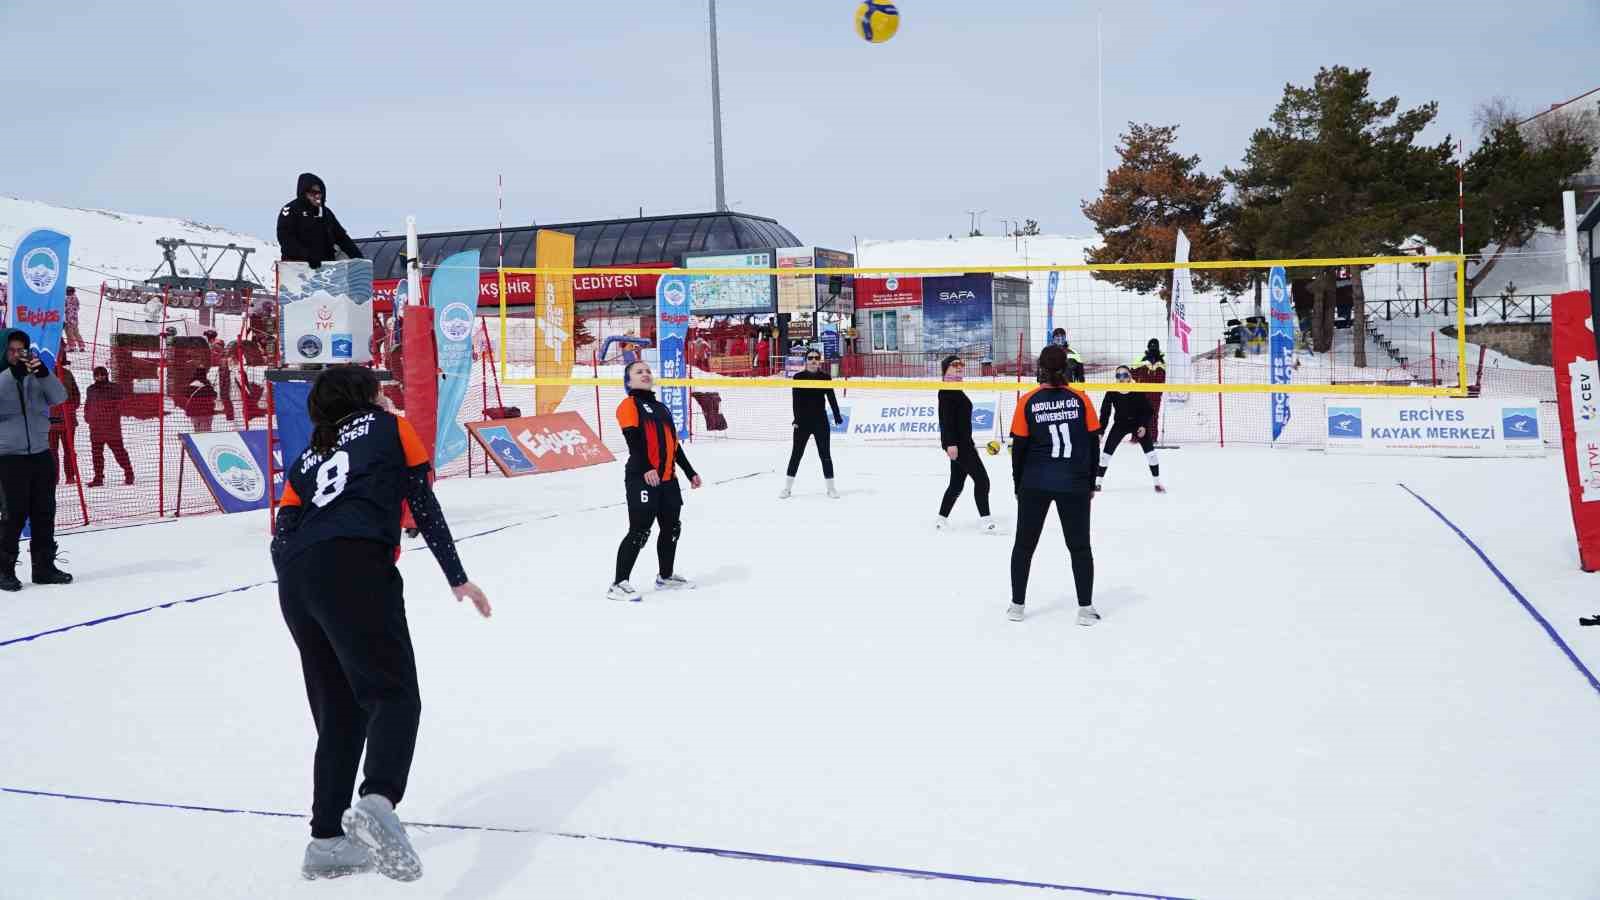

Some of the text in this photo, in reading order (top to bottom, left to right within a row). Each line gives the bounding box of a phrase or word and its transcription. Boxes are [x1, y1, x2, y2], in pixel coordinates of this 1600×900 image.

[316, 322, 335, 330] TVF
[1581, 373, 1592, 402] CEV
[1399, 406, 1465, 422] ERCİYES
[854, 422, 896, 435] KAYAK
[1371, 425, 1495, 440] KAYAK MERKEZİ
[1048, 422, 1072, 458] 11
[311, 450, 350, 508] 8
[640, 490, 649, 503] 6
